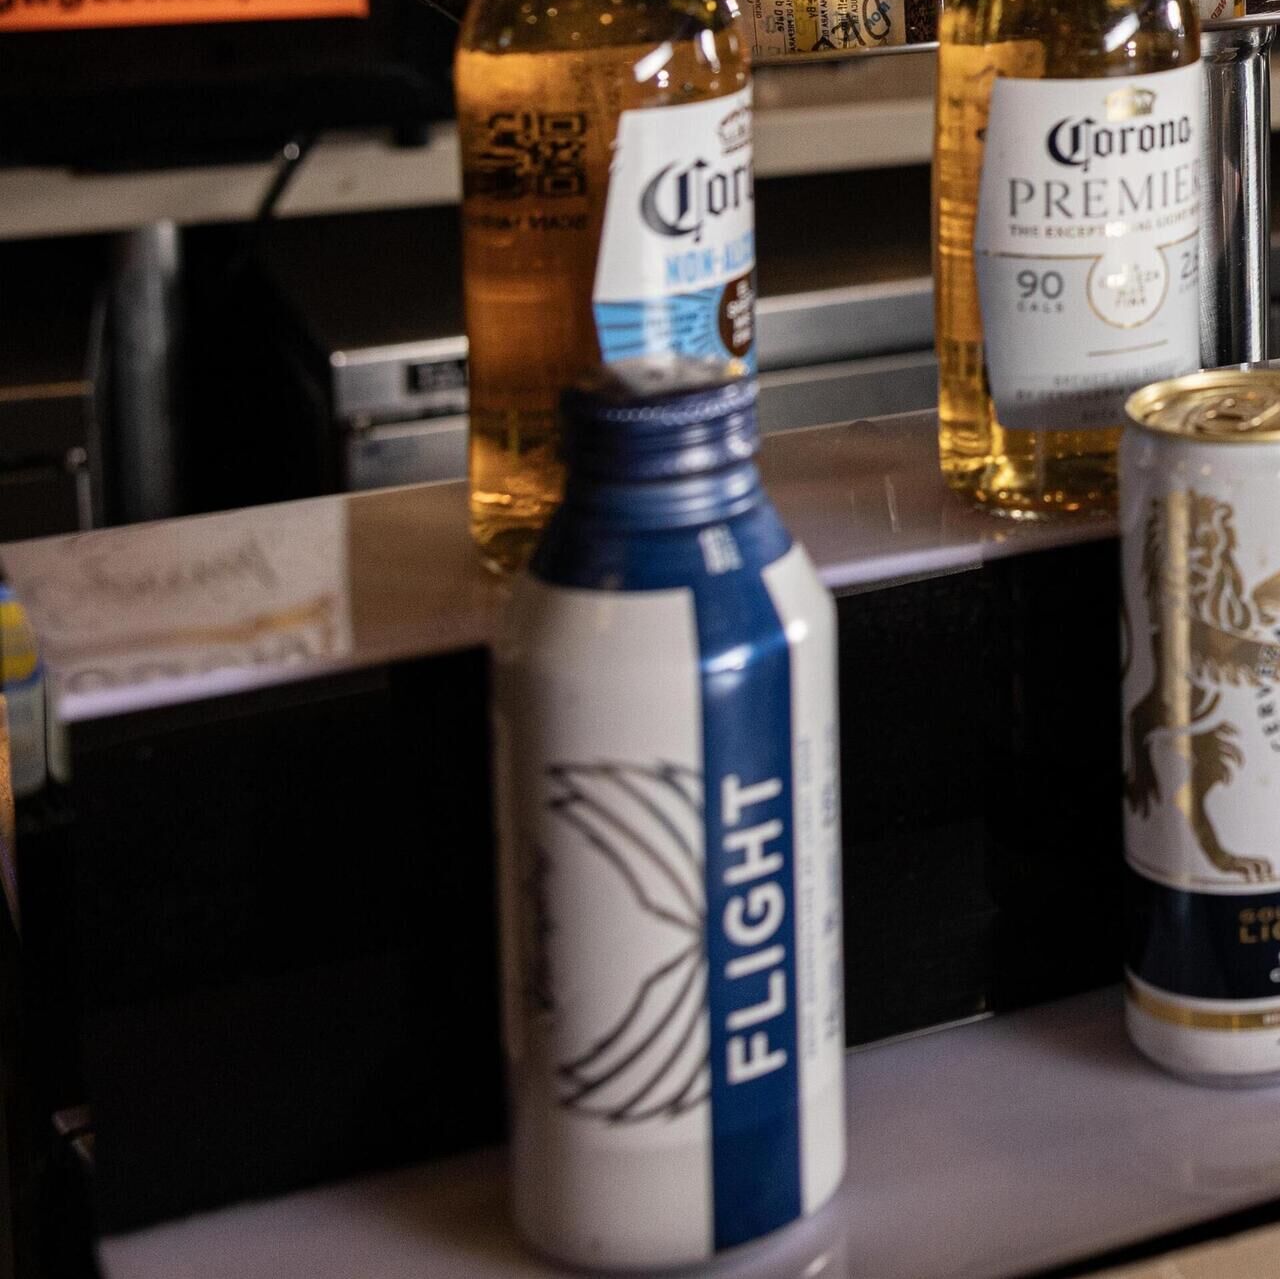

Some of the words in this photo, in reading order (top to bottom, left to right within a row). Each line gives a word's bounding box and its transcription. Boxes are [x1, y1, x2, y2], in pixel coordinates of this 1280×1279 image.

[1046, 114, 1193, 172] Corona
[637, 159, 754, 243] Cor
[1016, 269, 1064, 300] 90
[721, 774, 788, 1086] FLIGHT
